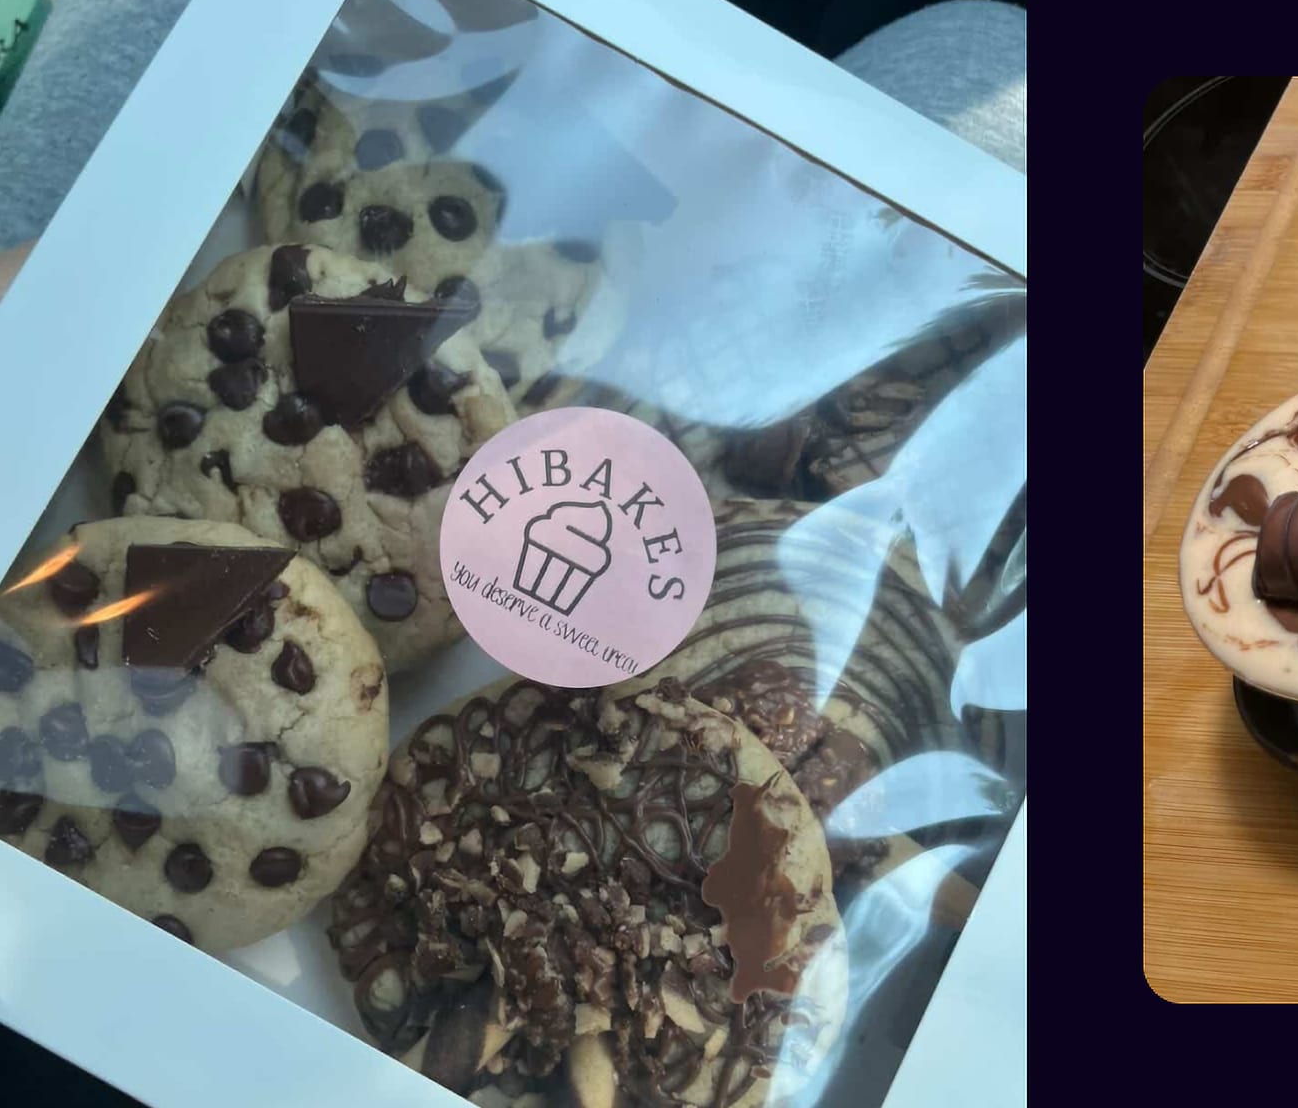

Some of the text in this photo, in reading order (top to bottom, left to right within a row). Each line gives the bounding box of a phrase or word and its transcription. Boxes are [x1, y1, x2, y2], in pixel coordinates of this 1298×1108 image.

[459, 449, 685, 601] HIBAKES
[449, 560, 481, 592] you
[481, 576, 539, 622] deserve
[539, 612, 552, 631] a
